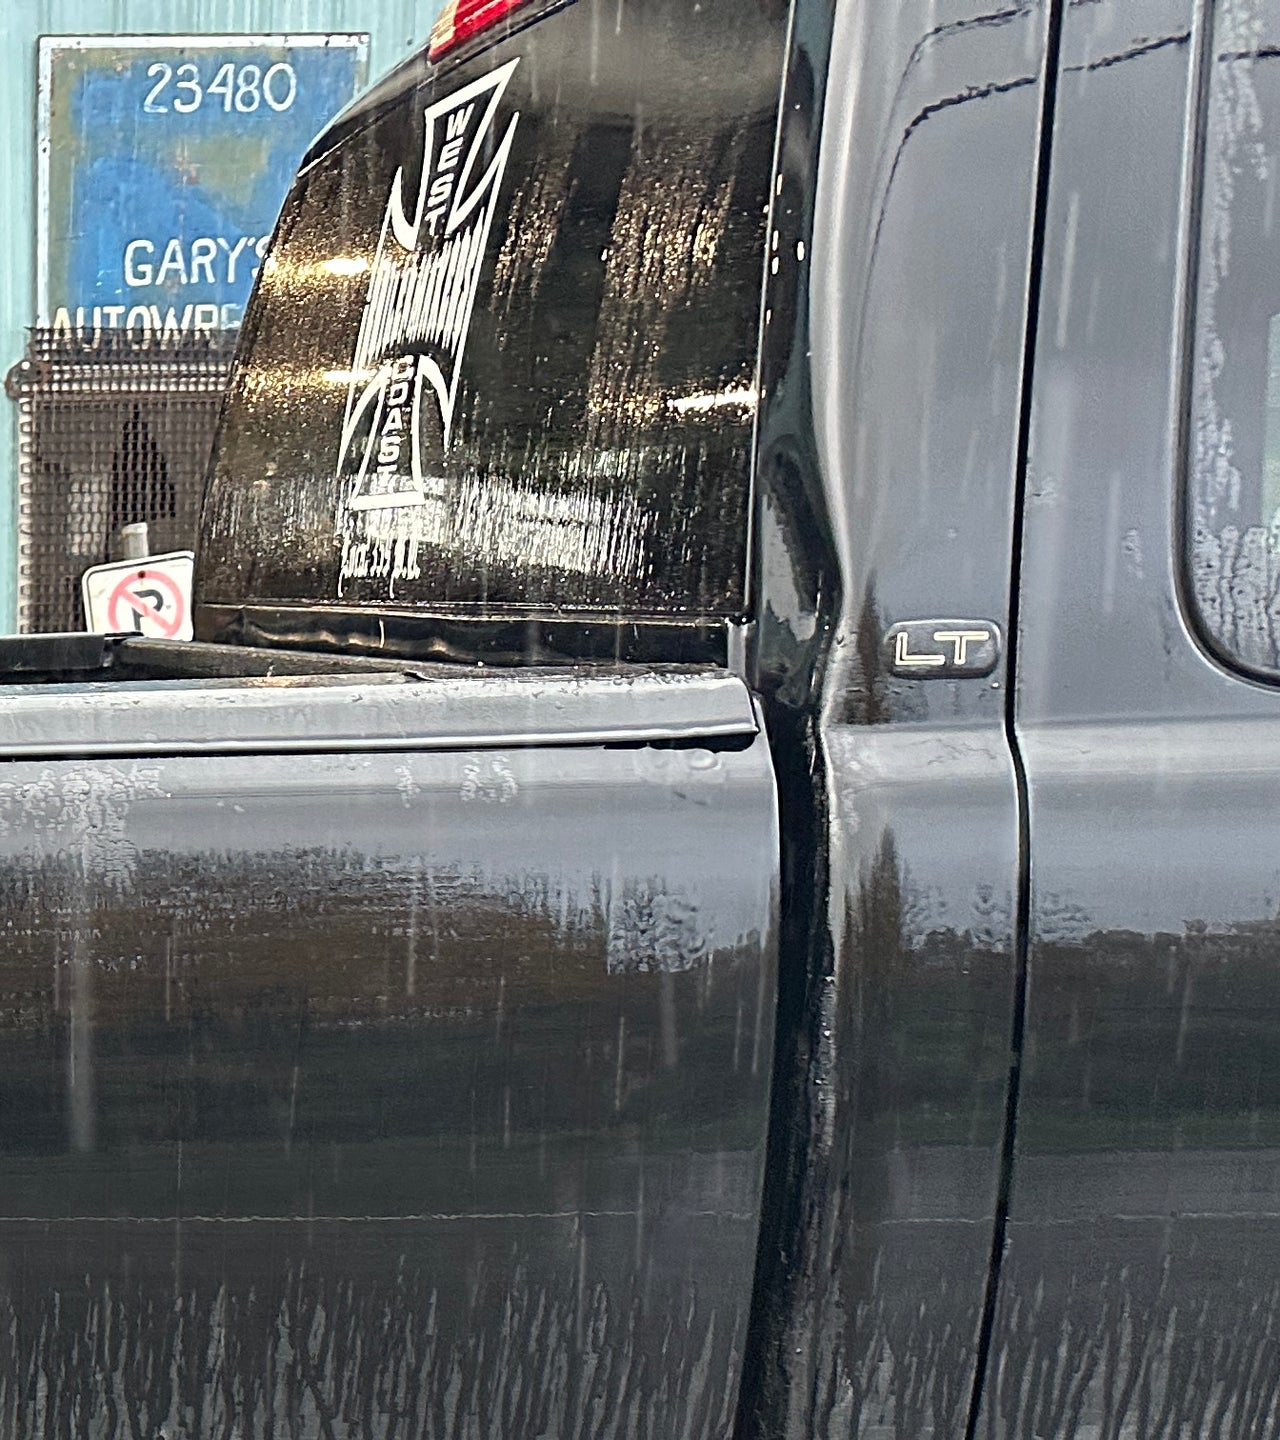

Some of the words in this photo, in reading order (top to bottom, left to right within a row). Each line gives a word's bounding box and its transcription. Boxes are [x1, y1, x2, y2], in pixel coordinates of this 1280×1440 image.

[143, 62, 297, 114] 23480
[424, 102, 476, 237] WEST
[895, 630, 990, 667] LT
